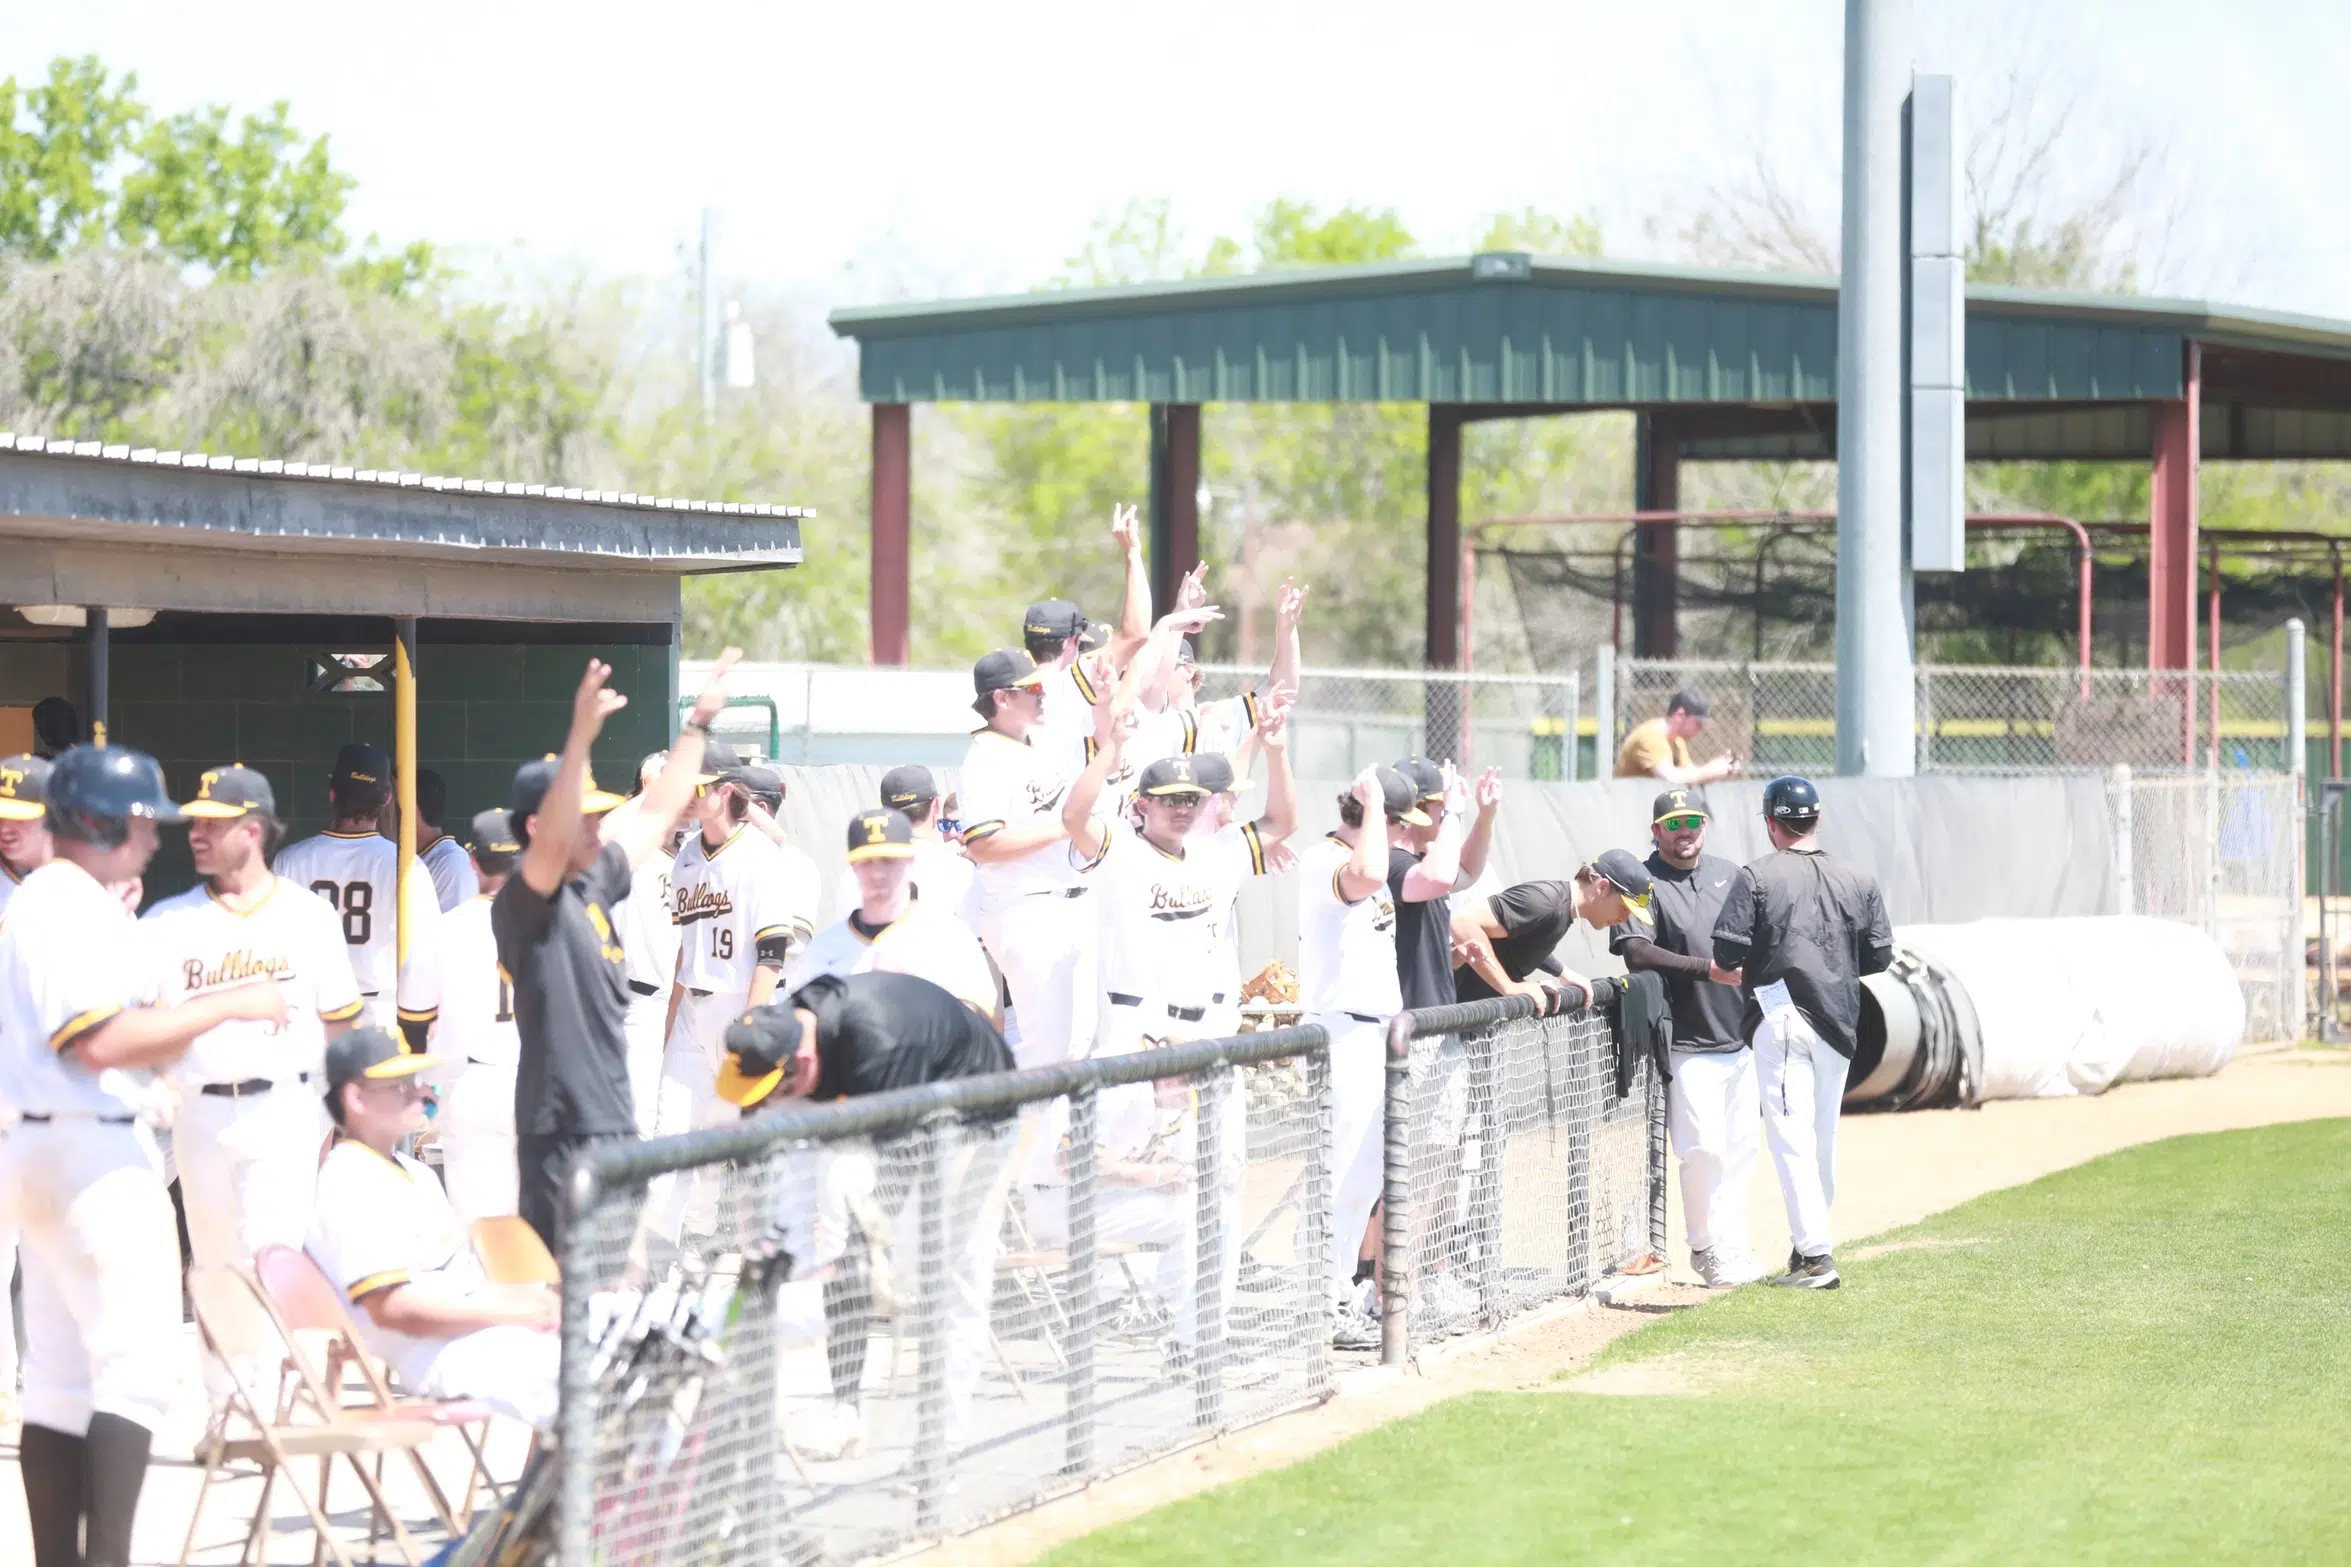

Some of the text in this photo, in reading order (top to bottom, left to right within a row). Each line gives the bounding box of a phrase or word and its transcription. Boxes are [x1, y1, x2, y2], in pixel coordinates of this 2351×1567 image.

[1173, 760, 1190, 781] T
[1670, 790, 1687, 808] T
[863, 816, 888, 844] T
[712, 927, 733, 960] 19
[183, 948, 289, 991] Bulldogs
